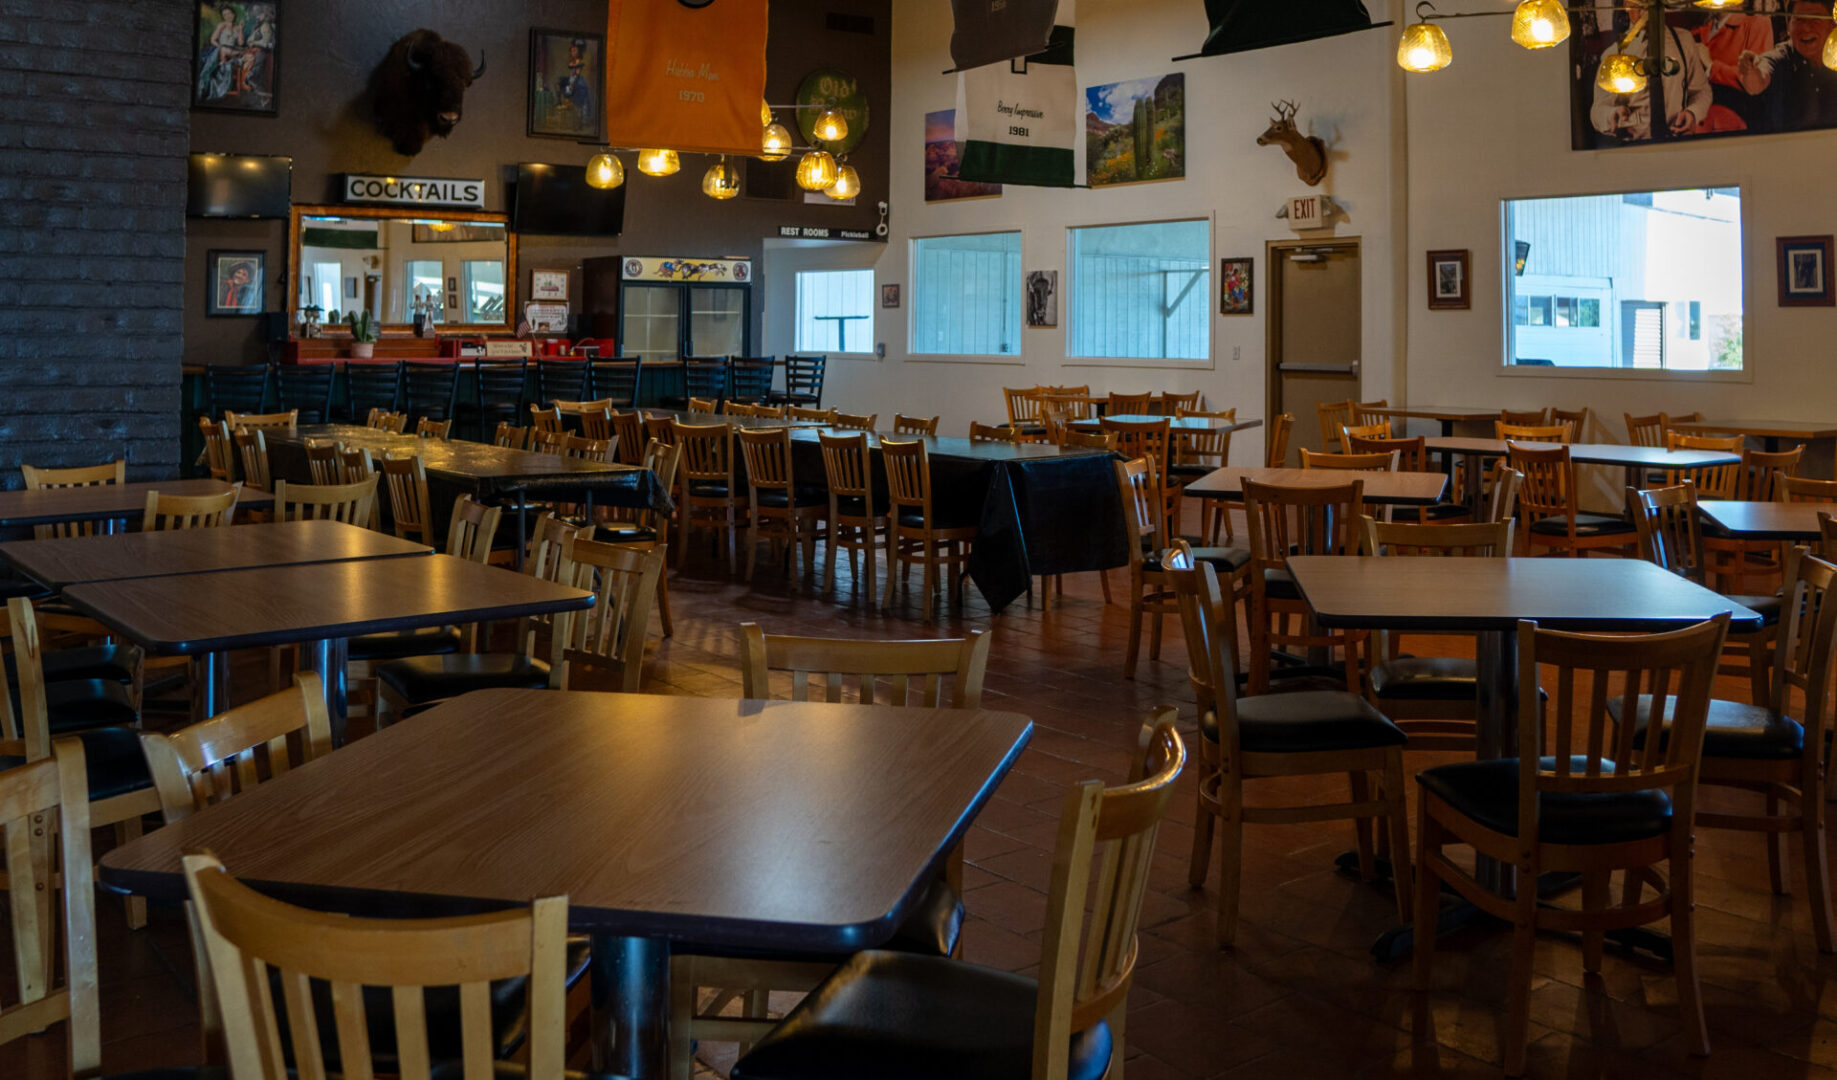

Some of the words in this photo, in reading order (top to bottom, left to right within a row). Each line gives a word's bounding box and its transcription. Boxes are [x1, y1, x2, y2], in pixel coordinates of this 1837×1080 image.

[679, 90, 704, 104] 1970
[1008, 126, 1029, 137] 1981
[350, 179, 479, 202] COCKTAILS
[1294, 198, 1316, 219] EXIT
[781, 226, 800, 236] REST
[803, 227, 829, 237] ROOMS
[840, 230, 870, 239] Pickleball
